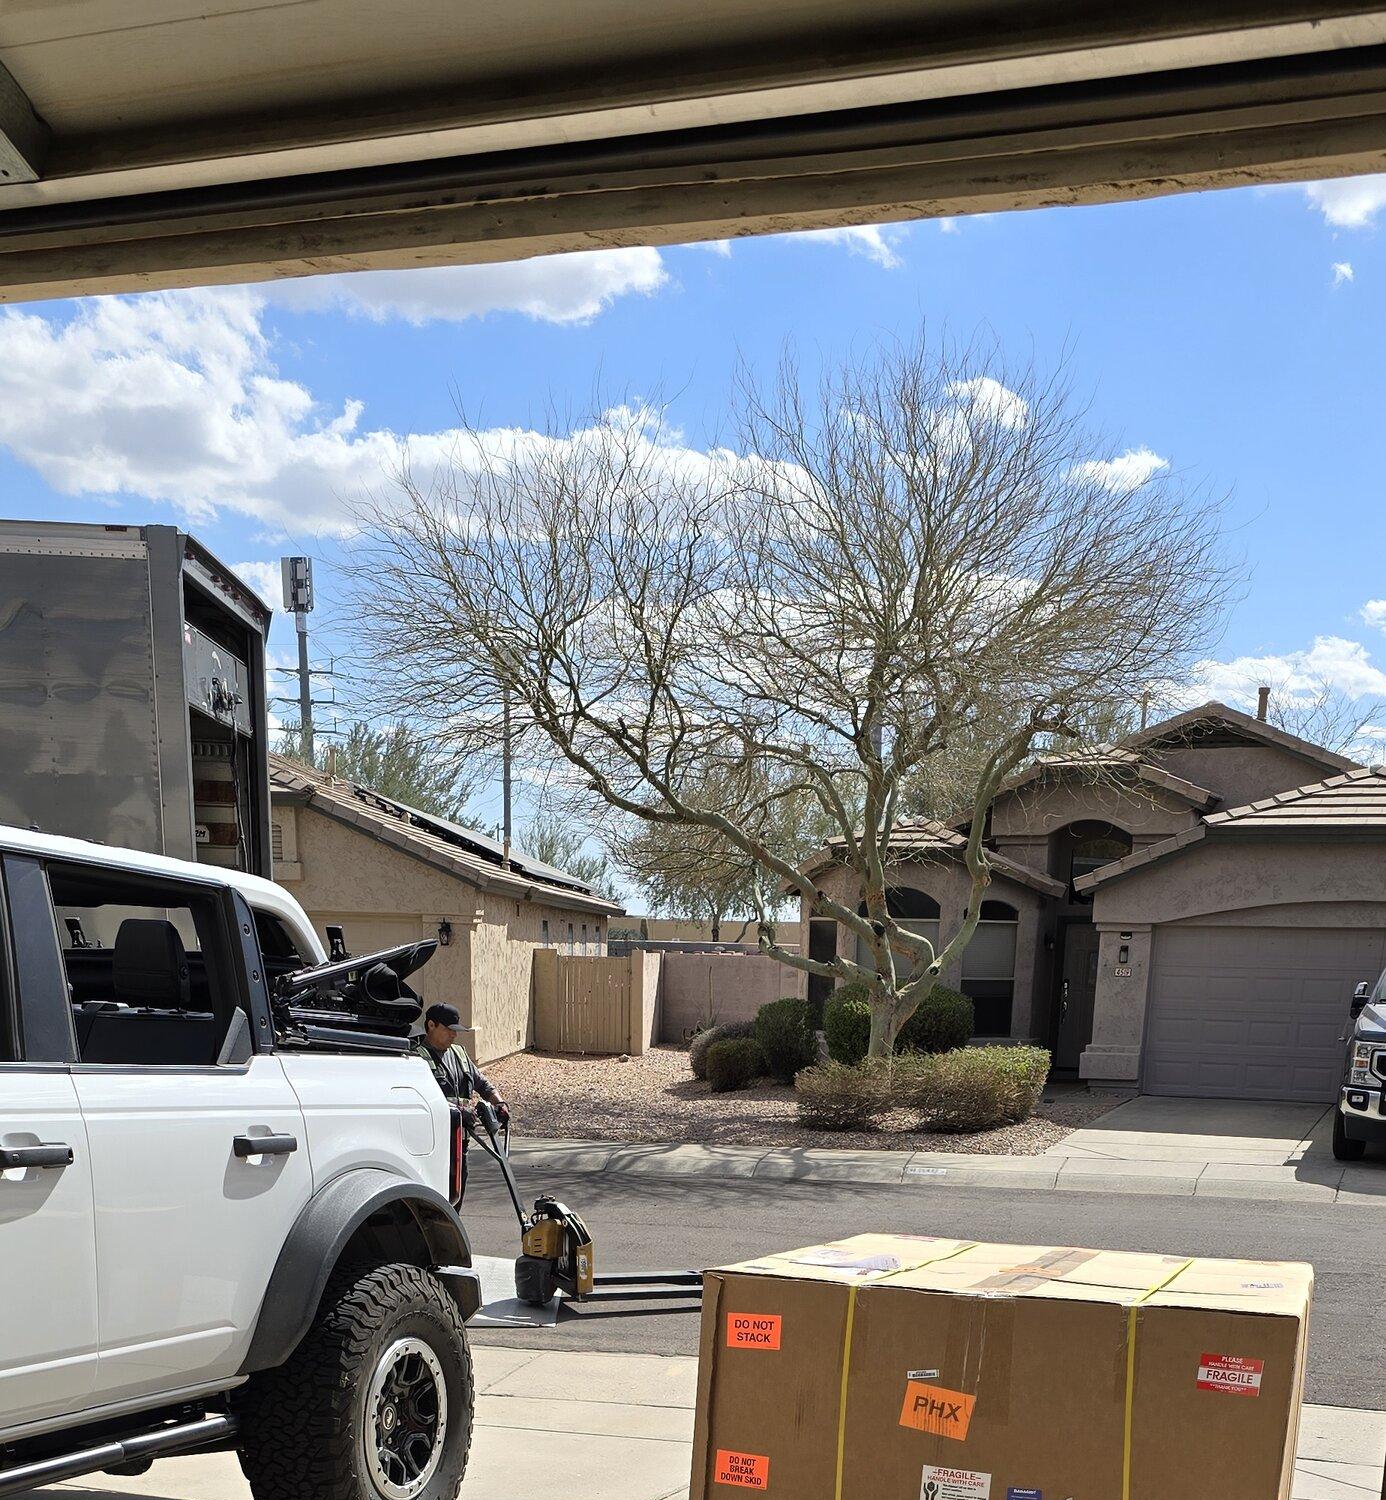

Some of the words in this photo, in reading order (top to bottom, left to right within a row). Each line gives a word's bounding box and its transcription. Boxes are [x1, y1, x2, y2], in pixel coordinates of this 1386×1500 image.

[734, 1319, 750, 1329] DO
[752, 1320, 775, 1331] NOT
[736, 1331, 771, 1343] STACK
[1221, 1356, 1244, 1365] PLEASE
[1206, 1369, 1254, 1385] FRAGILE
[913, 1395, 962, 1422] PHX
[729, 1455, 740, 1465] DO
[741, 1457, 757, 1467] NOT
[729, 1464, 755, 1476] BREAK
[720, 1472, 744, 1483] DOWN
[744, 1475, 762, 1486] SKID
[927, 1475, 952, 1484] HANDLE
[951, 1478, 967, 1486] WITH
[967, 1480, 985, 1488] CARE
